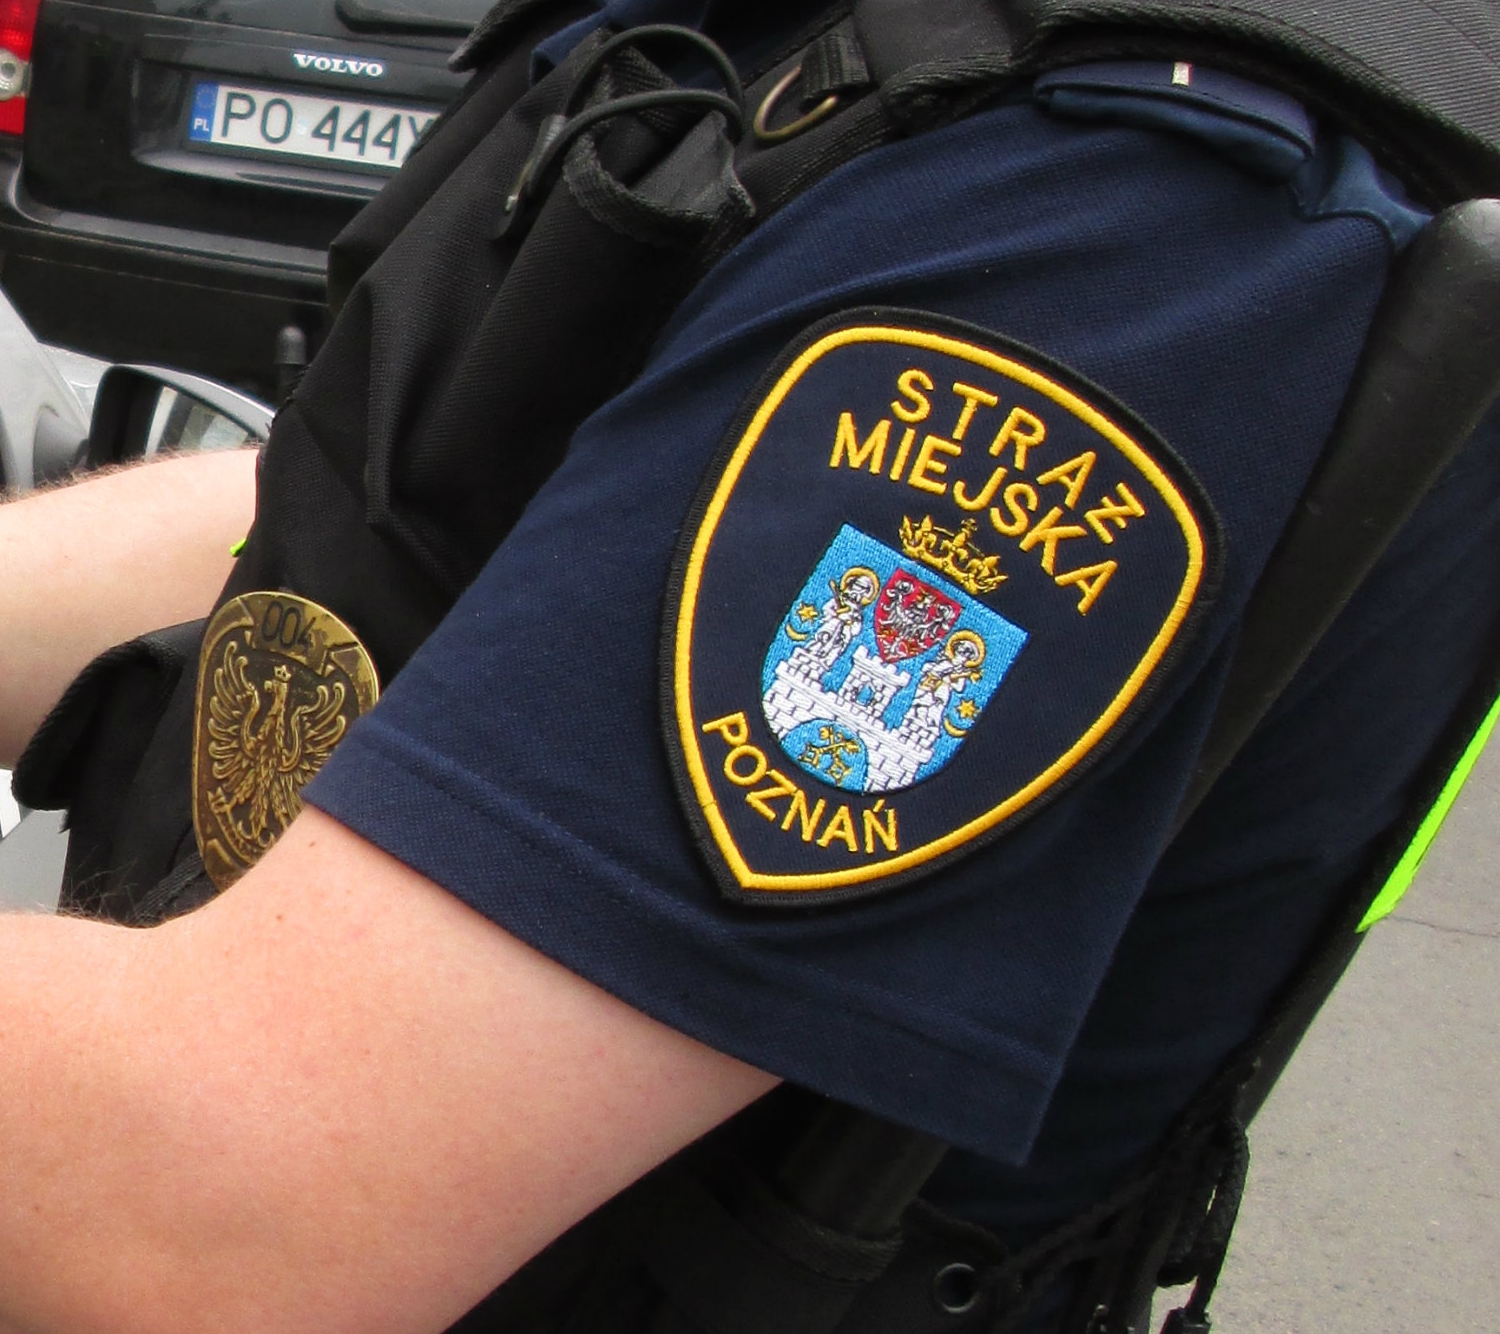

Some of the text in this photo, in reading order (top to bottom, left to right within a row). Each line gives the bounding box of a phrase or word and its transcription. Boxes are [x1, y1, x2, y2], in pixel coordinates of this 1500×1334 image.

[292, 53, 385, 78] VOLVO
[193, 117, 211, 133] PL
[220, 91, 295, 145] PO
[828, 411, 1120, 617] MIEJSKA
[701, 710, 900, 855] POZNAŃ
